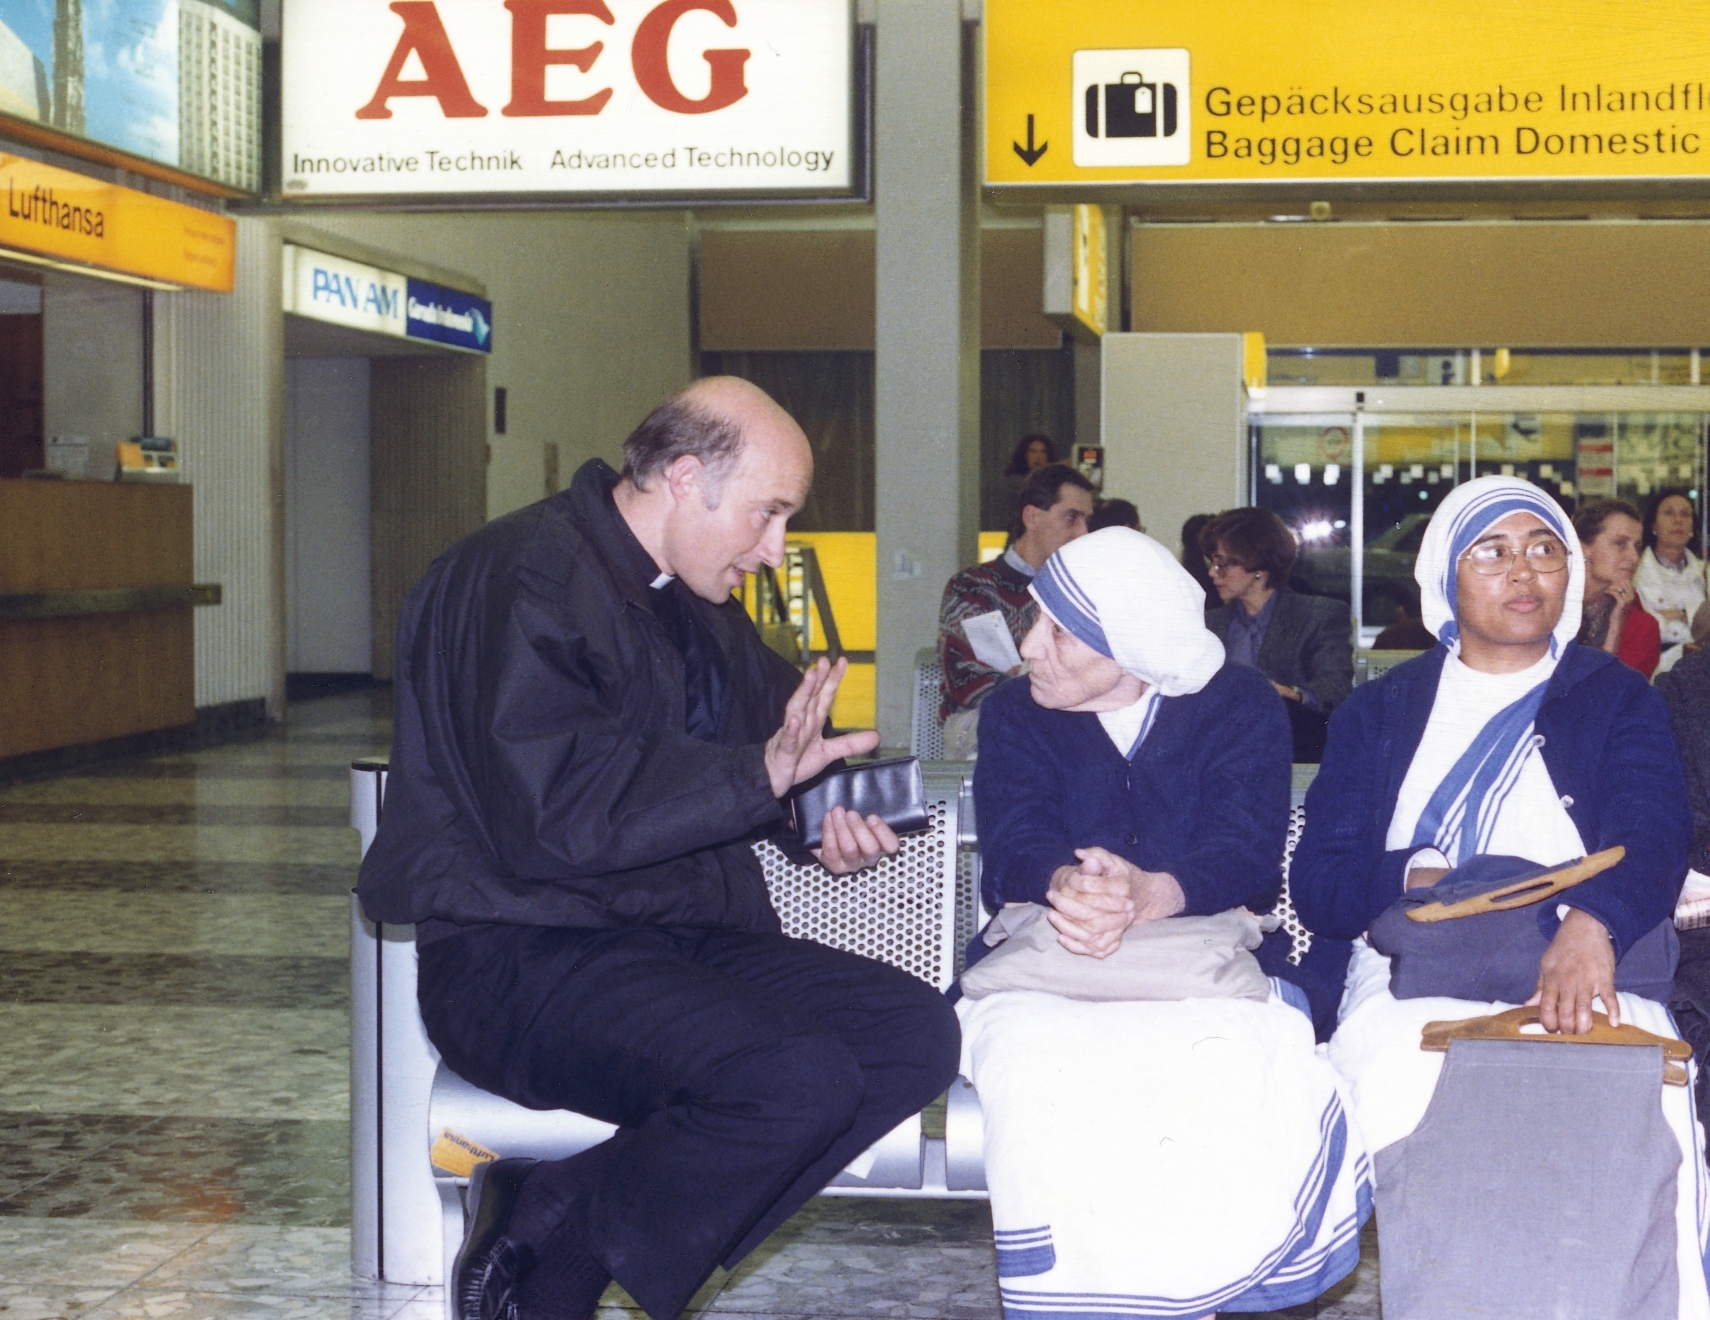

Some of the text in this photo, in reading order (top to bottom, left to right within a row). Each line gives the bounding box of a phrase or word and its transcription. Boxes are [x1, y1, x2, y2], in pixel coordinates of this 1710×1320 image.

[355, 0, 752, 119] AEG
[1205, 82, 1710, 122] Gepäcksausgabe Inlandfl
[292, 146, 835, 174] Innovative Technik Advanced Technology
[1206, 124, 1700, 165] Baggage Claim Domestic
[9, 176, 105, 239] Lufthansa
[312, 267, 360, 311] PAN
[363, 282, 399, 320] AM
